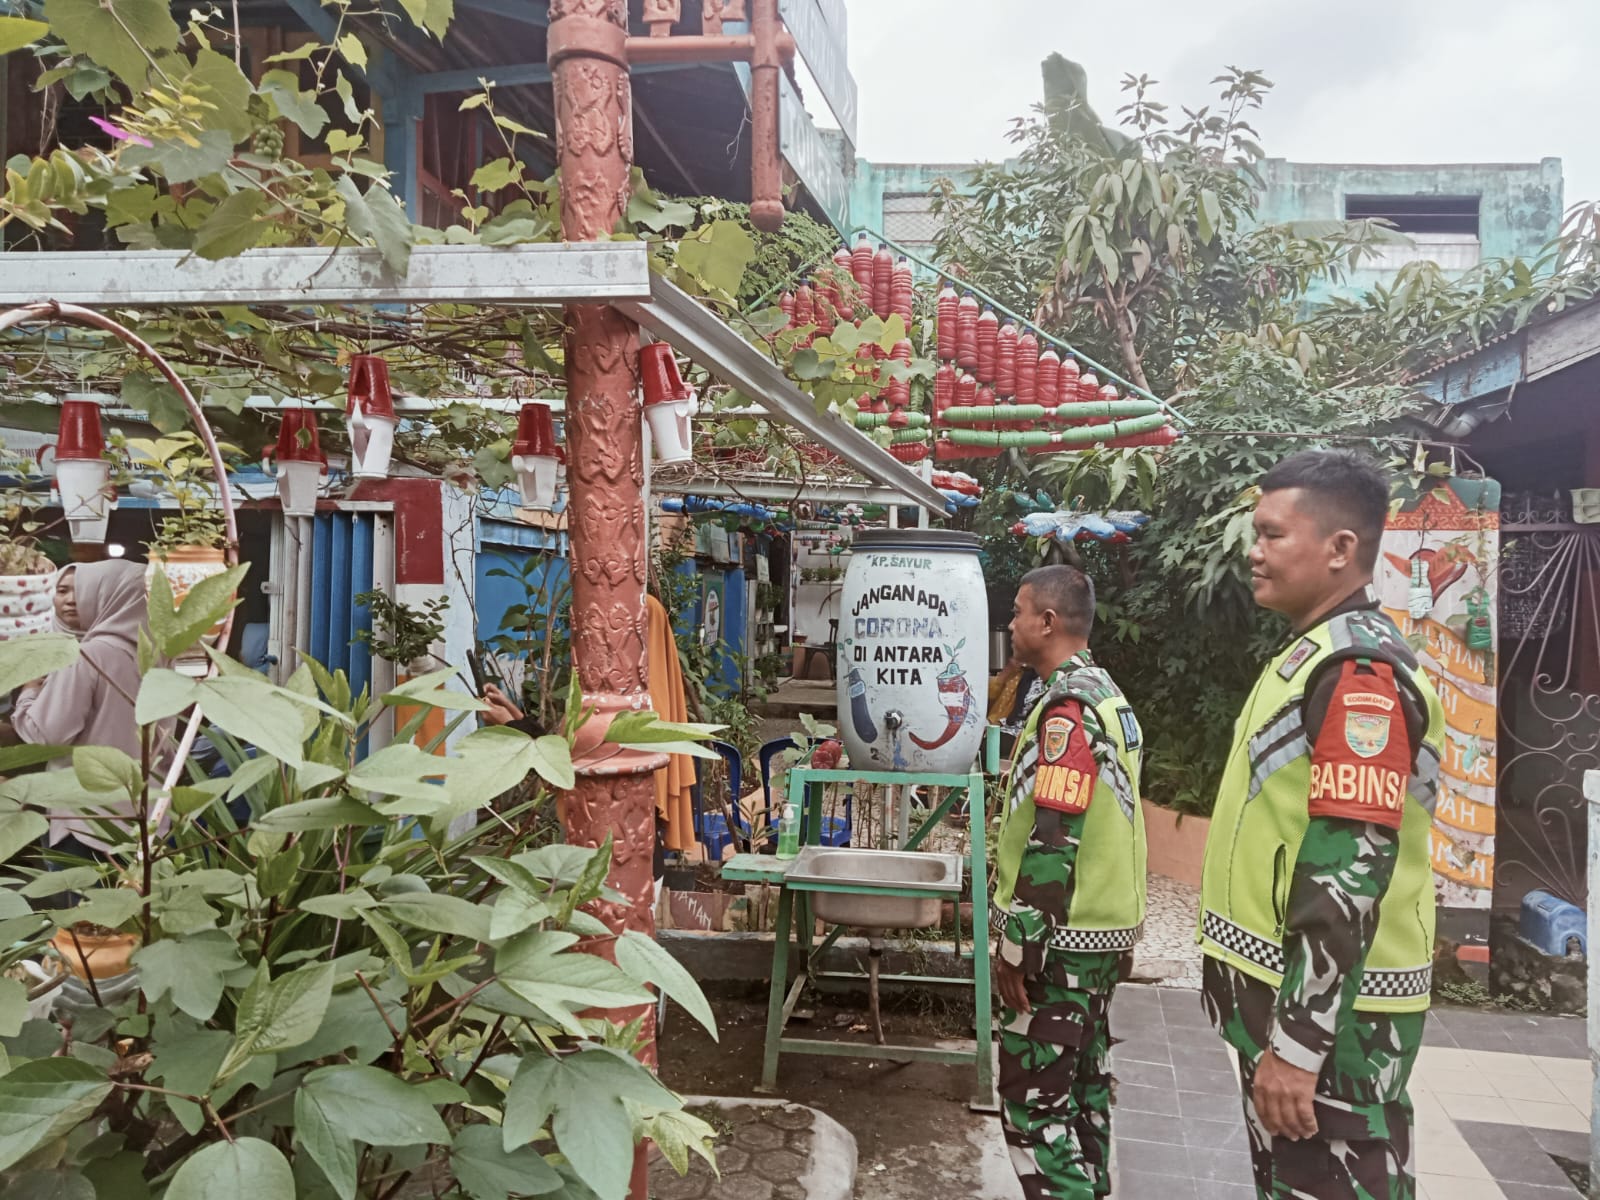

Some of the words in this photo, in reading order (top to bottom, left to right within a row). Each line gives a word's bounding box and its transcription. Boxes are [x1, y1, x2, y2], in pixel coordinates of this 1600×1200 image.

[852, 584, 915, 616] JANGAN
[917, 590, 948, 616] ADA
[855, 618, 942, 638] CORONA
[854, 646, 866, 662] DI
[874, 646, 943, 662] ANTARA
[877, 668, 922, 685] KITA
